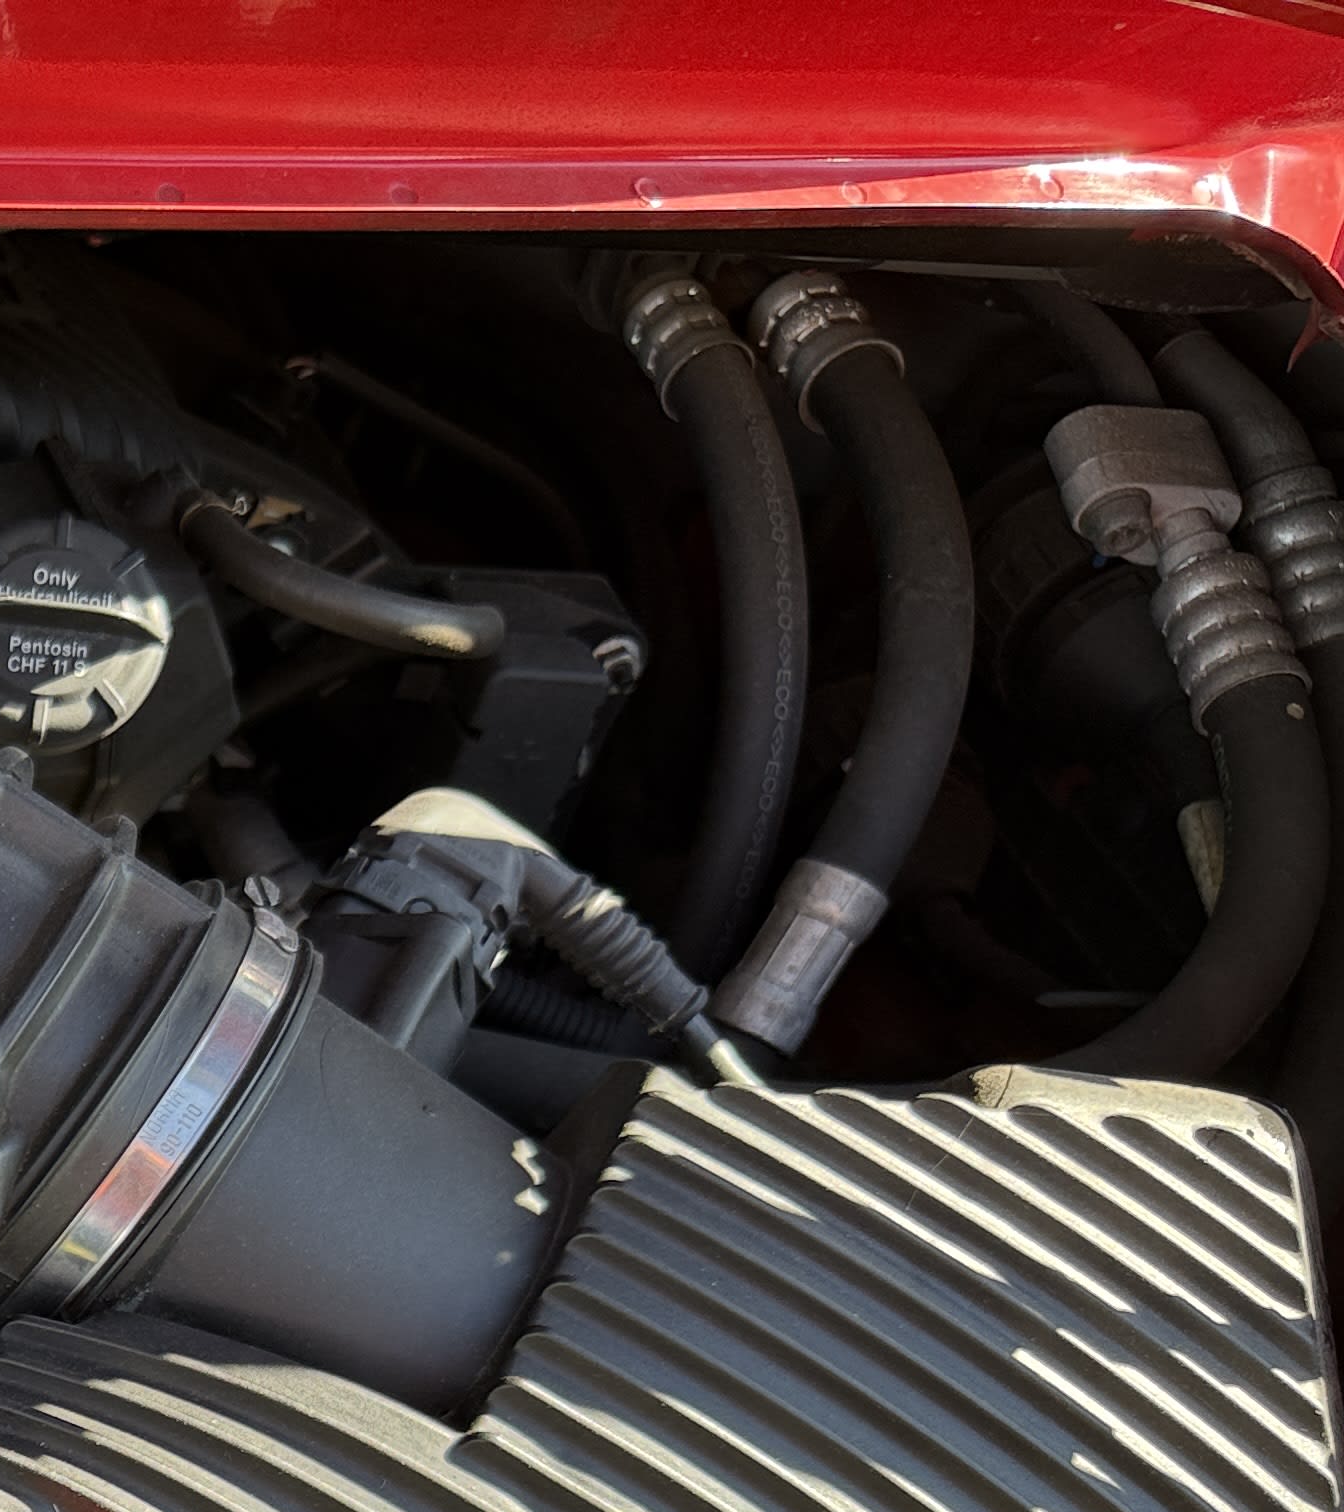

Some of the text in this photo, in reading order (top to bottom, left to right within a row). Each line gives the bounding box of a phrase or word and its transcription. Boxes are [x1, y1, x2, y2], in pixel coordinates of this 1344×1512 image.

[33, 566, 81, 590] Only
[9, 635, 88, 658] Pentosin
[7, 655, 85, 678] CHF 11 S
[159, 1103, 203, 1158] 90-110
